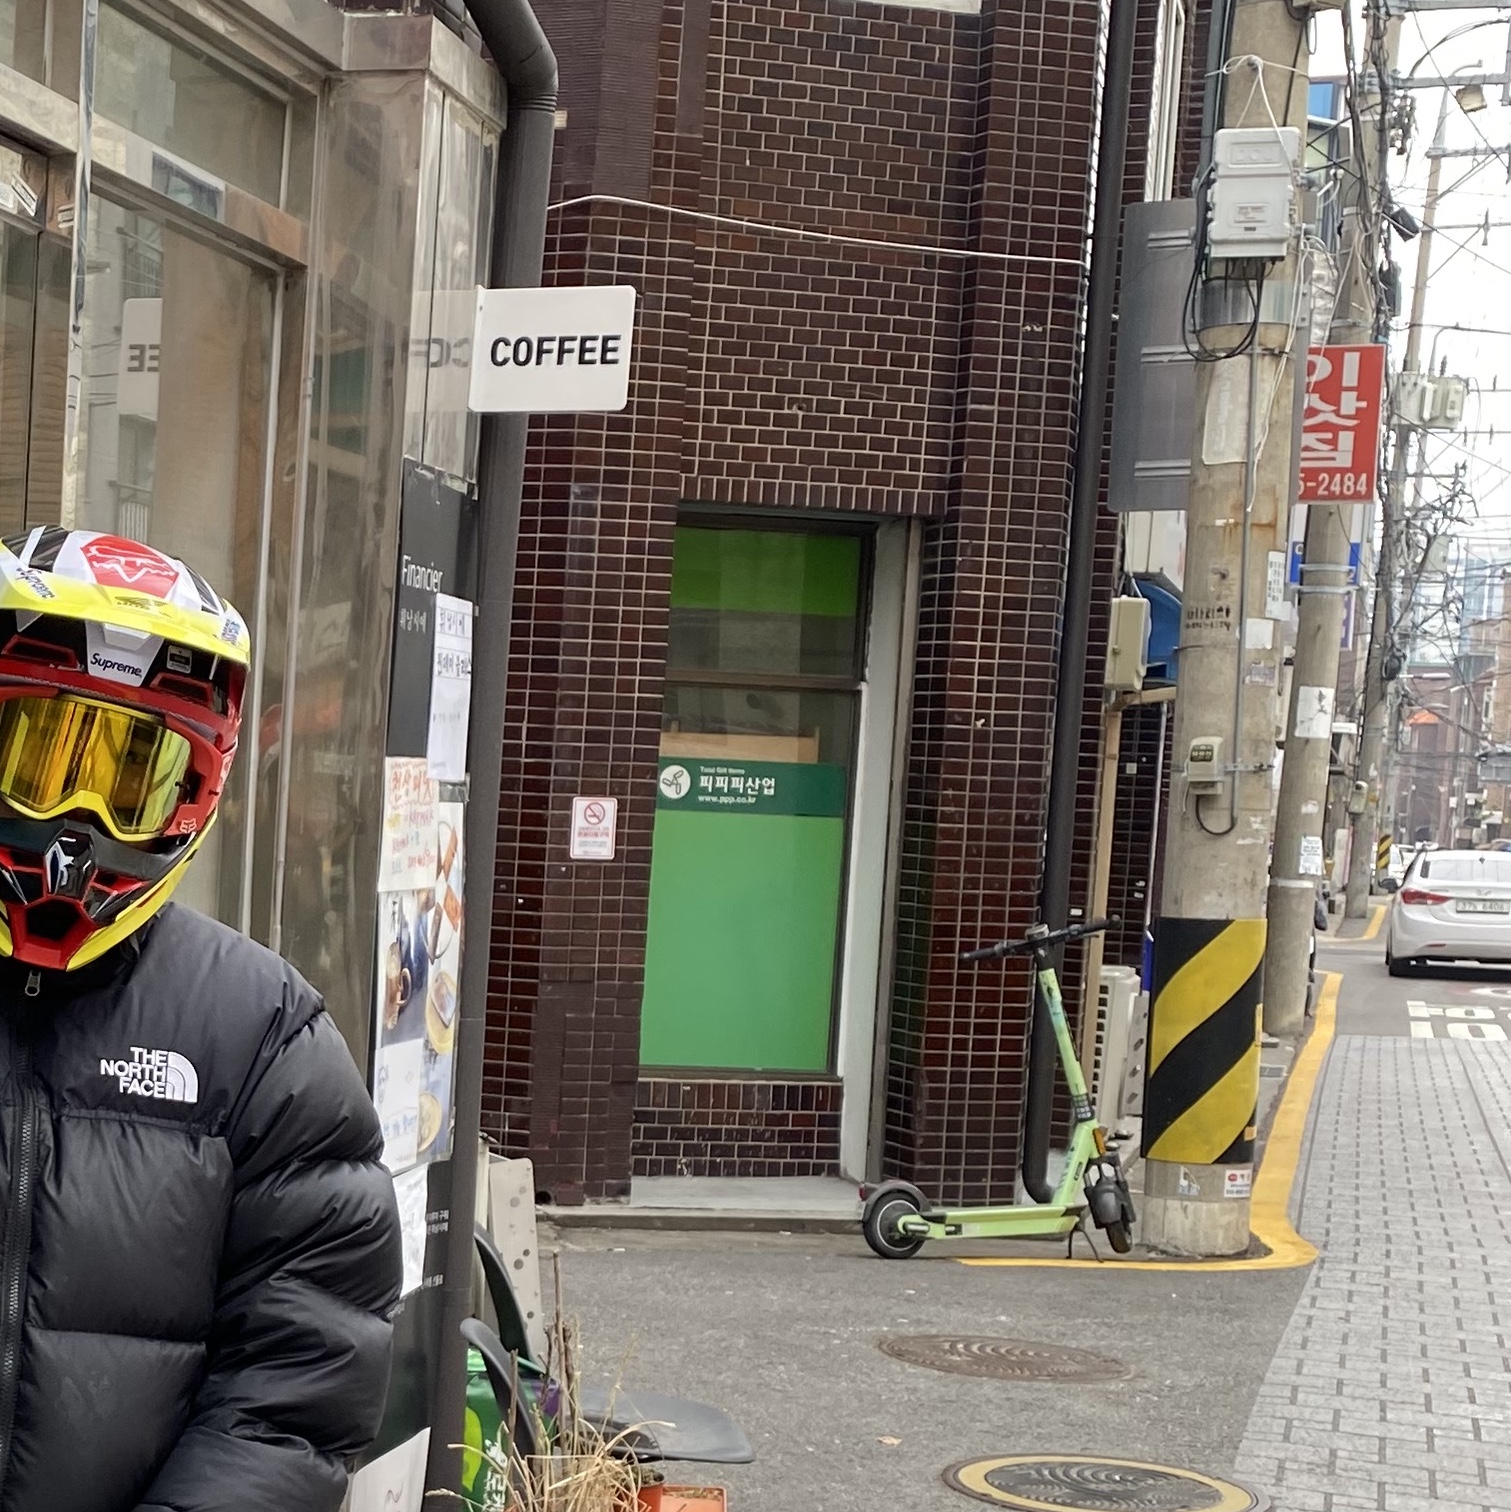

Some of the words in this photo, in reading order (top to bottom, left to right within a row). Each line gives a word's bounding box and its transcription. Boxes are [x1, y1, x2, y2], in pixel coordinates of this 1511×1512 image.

[490, 334, 622, 367] COFFEE
[401, 554, 443, 593] Financier
[90, 652, 143, 679] Supreme
[699, 775, 776, 796] 피피피산업
[130, 1046, 169, 1067] THE
[100, 1059, 167, 1083] NORTH
[119, 1076, 167, 1099] FACE
